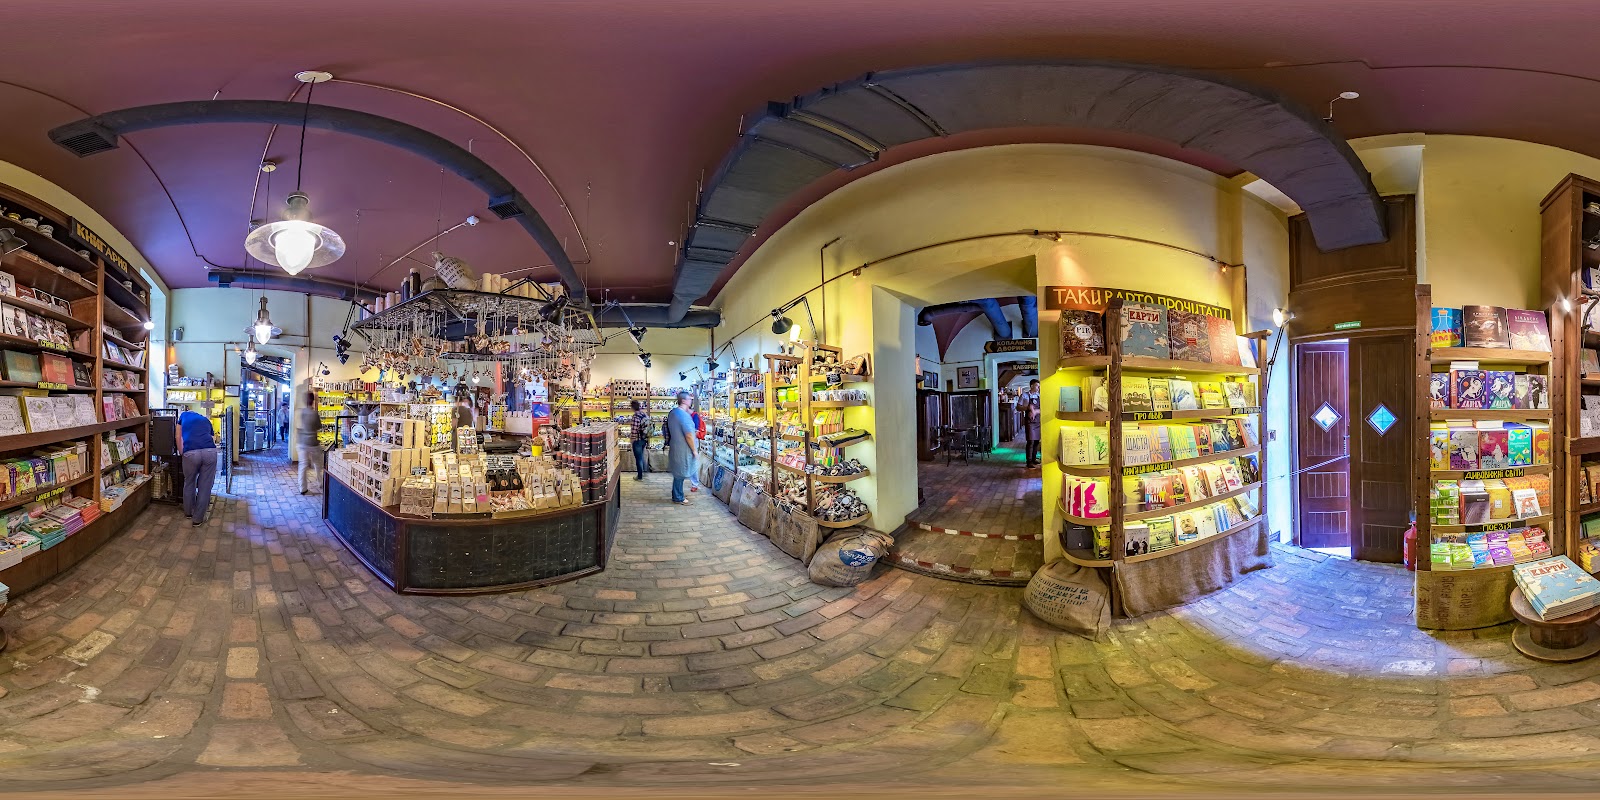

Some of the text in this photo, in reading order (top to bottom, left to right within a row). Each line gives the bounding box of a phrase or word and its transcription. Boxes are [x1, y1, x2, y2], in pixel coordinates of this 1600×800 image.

[76, 223, 128, 273] КНИГАРНЯ
[1053, 289, 1101, 305] ТАКИ
[1129, 310, 1159, 322] КАРТИ
[1465, 469, 1524, 480] ДИВОВИЖНІ СВІТИ
[1482, 522, 1512, 531] ПОЕЗІЯ
[1530, 563, 1567, 577] КАРТИ
